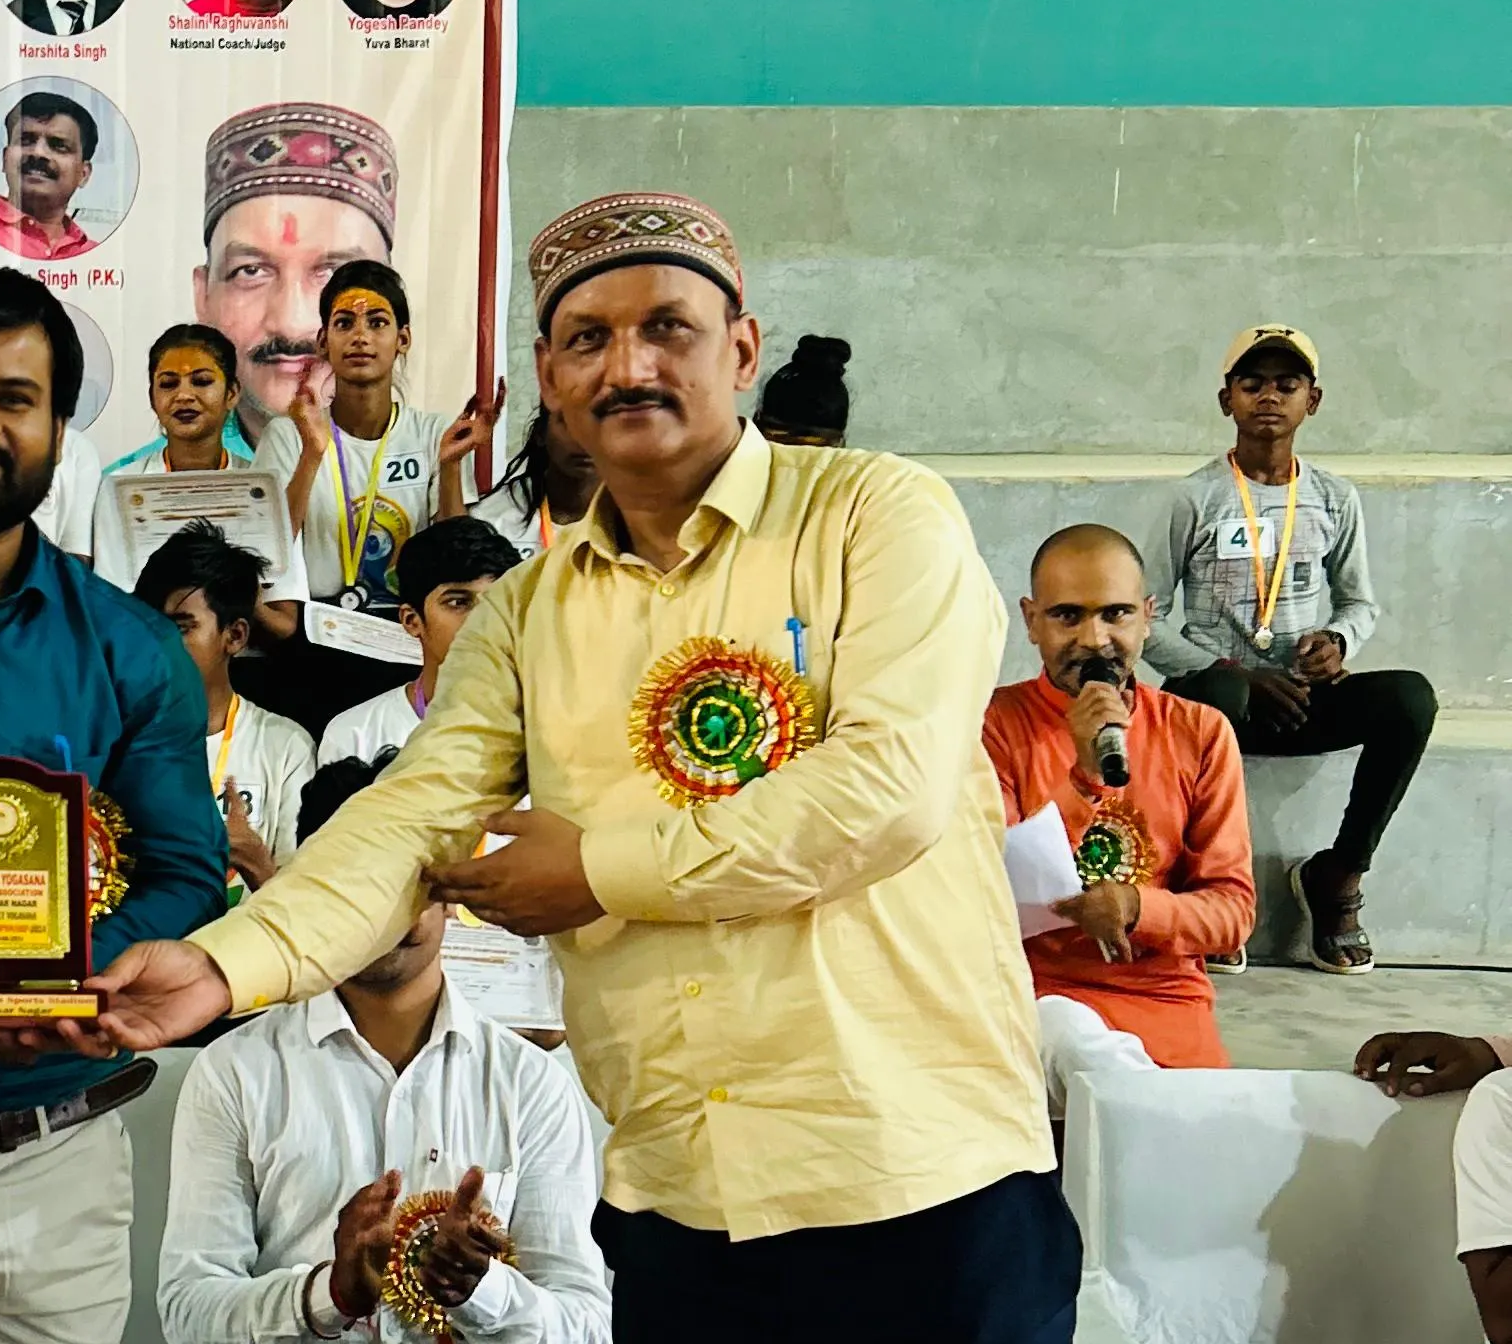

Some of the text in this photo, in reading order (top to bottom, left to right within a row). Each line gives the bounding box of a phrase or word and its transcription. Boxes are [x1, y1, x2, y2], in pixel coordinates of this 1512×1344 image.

[168, 14, 289, 33] Shalini Raghuvanshi
[348, 16, 450, 33] Yogesh Pandey
[19, 43, 107, 61] Harshita Singh
[170, 38, 215, 50] National
[365, 37, 430, 50] Yuva Bharat
[37, 269, 125, 291] Singh (P.K.)
[386, 458, 420, 482] 20
